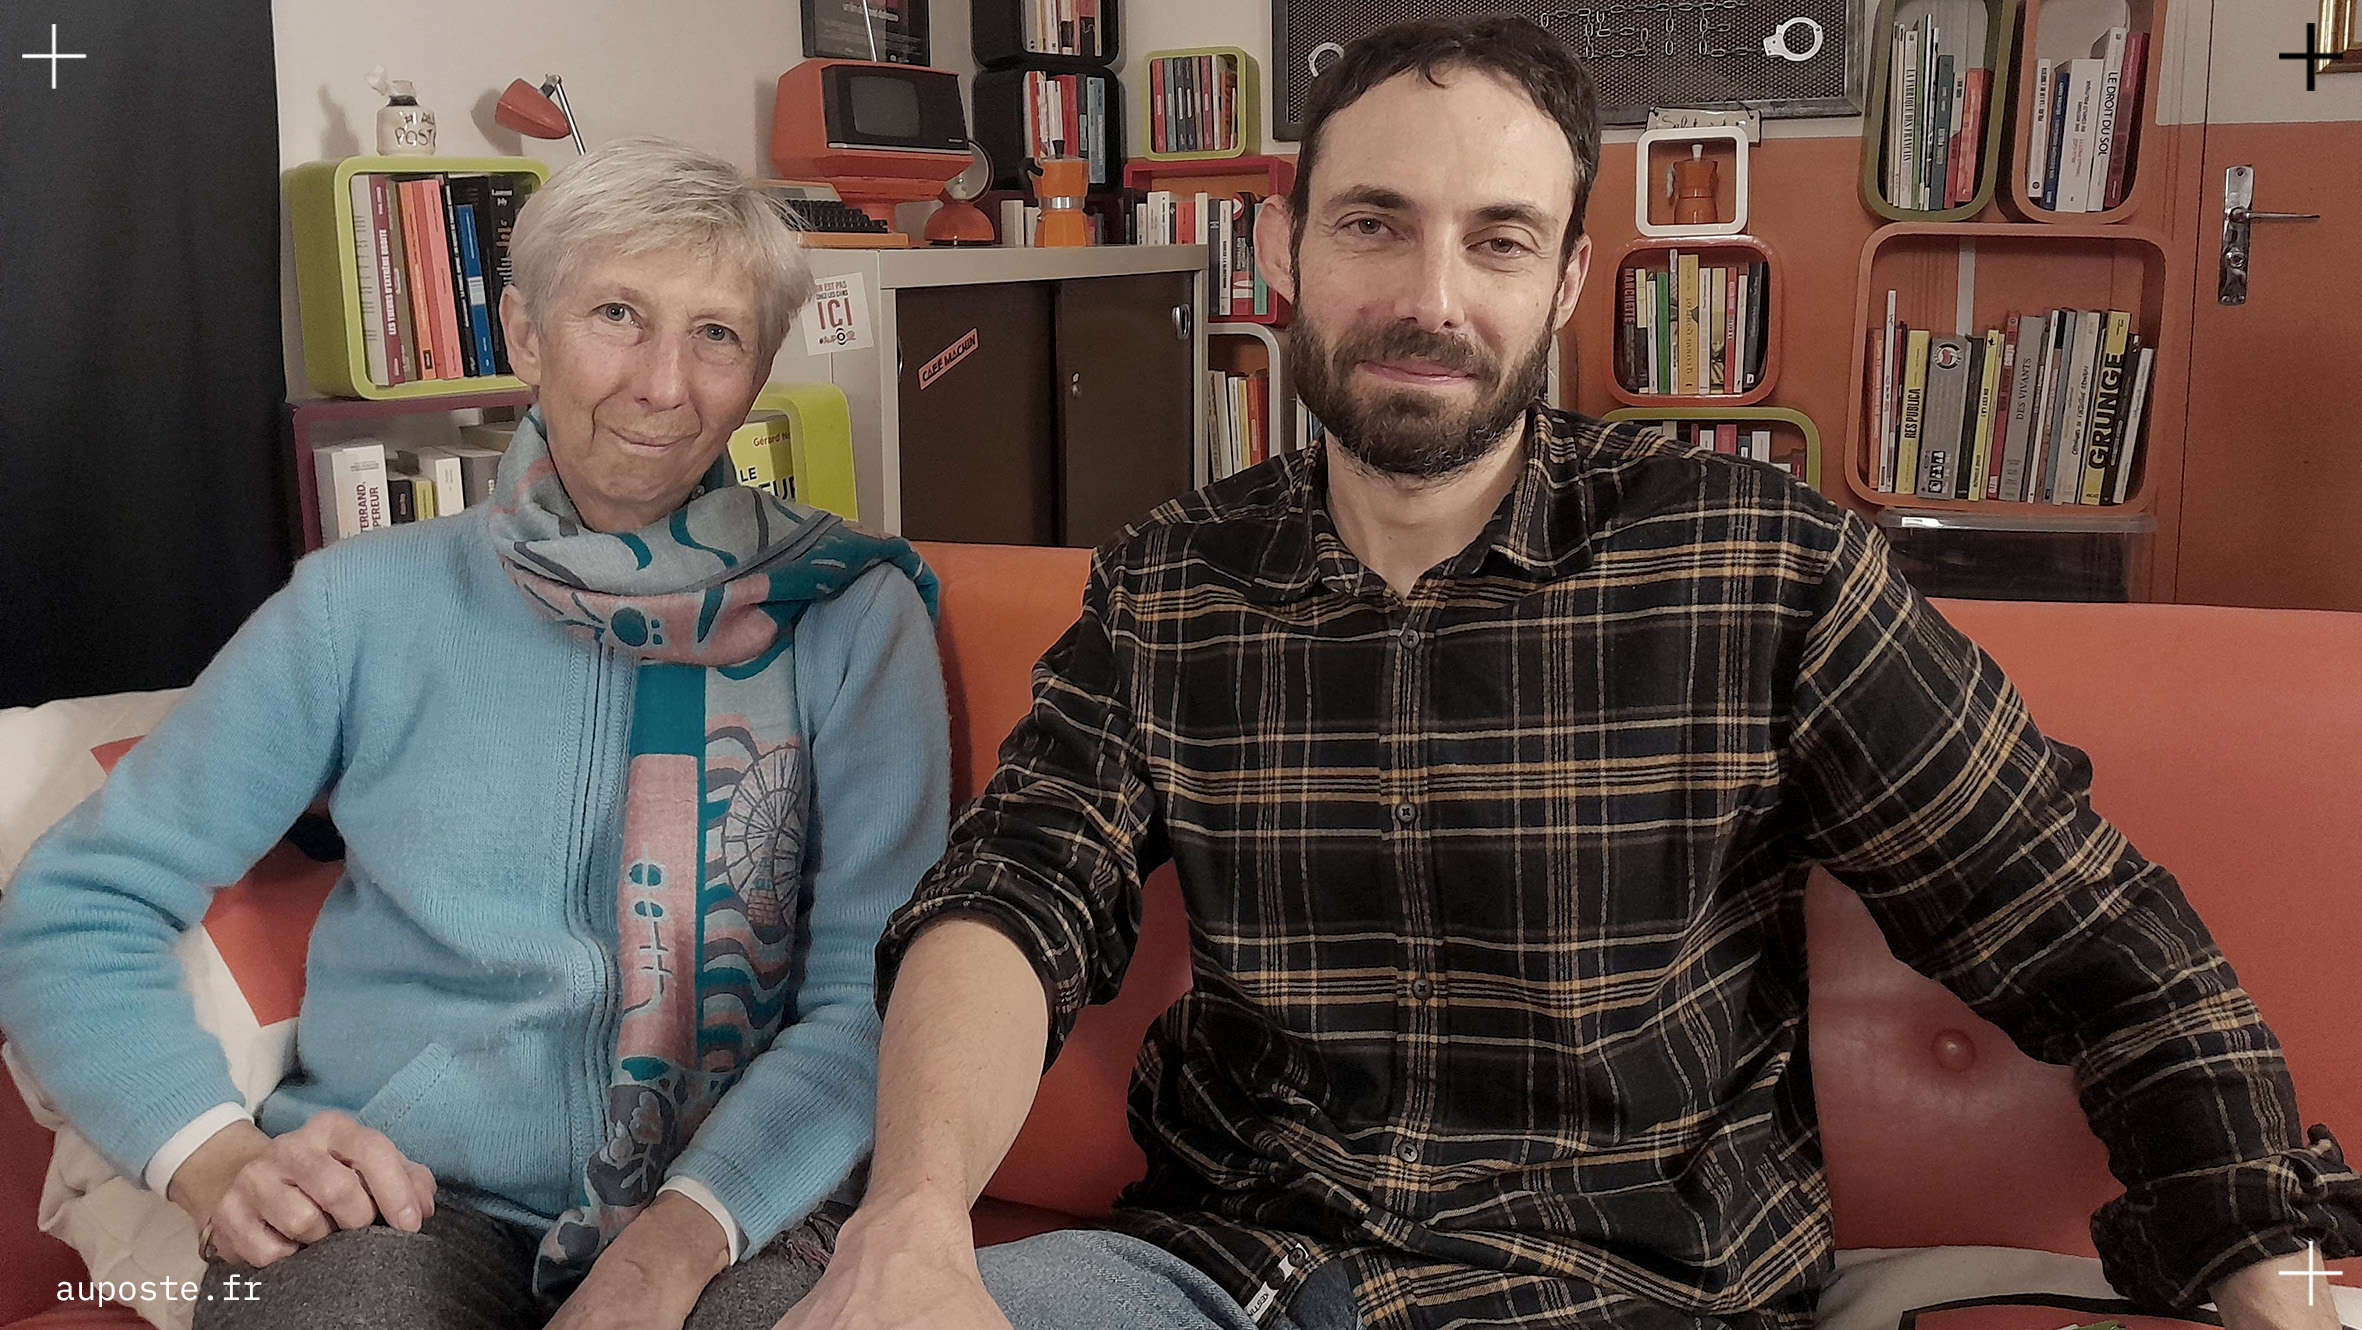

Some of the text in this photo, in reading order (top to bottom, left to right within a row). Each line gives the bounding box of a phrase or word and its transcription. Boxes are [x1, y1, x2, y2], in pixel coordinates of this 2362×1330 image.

[2098, 72, 2118, 156] LE DROIT DU SOL
[394, 126, 436, 146] POST
[835, 280, 848, 290] PAS
[817, 297, 853, 330] ICI
[388, 322, 397, 336] LES
[2016, 357, 2032, 420] DES VIVANTS
[1904, 388, 1921, 439] RES PUBLICA
[2088, 353, 2125, 469] GRUNGE
[753, 433, 781, 447] Gérard
[740, 466, 758, 482] LE
[369, 486, 381, 527] PEREUR
[1247, 1292, 1270, 1318] KESTIN
